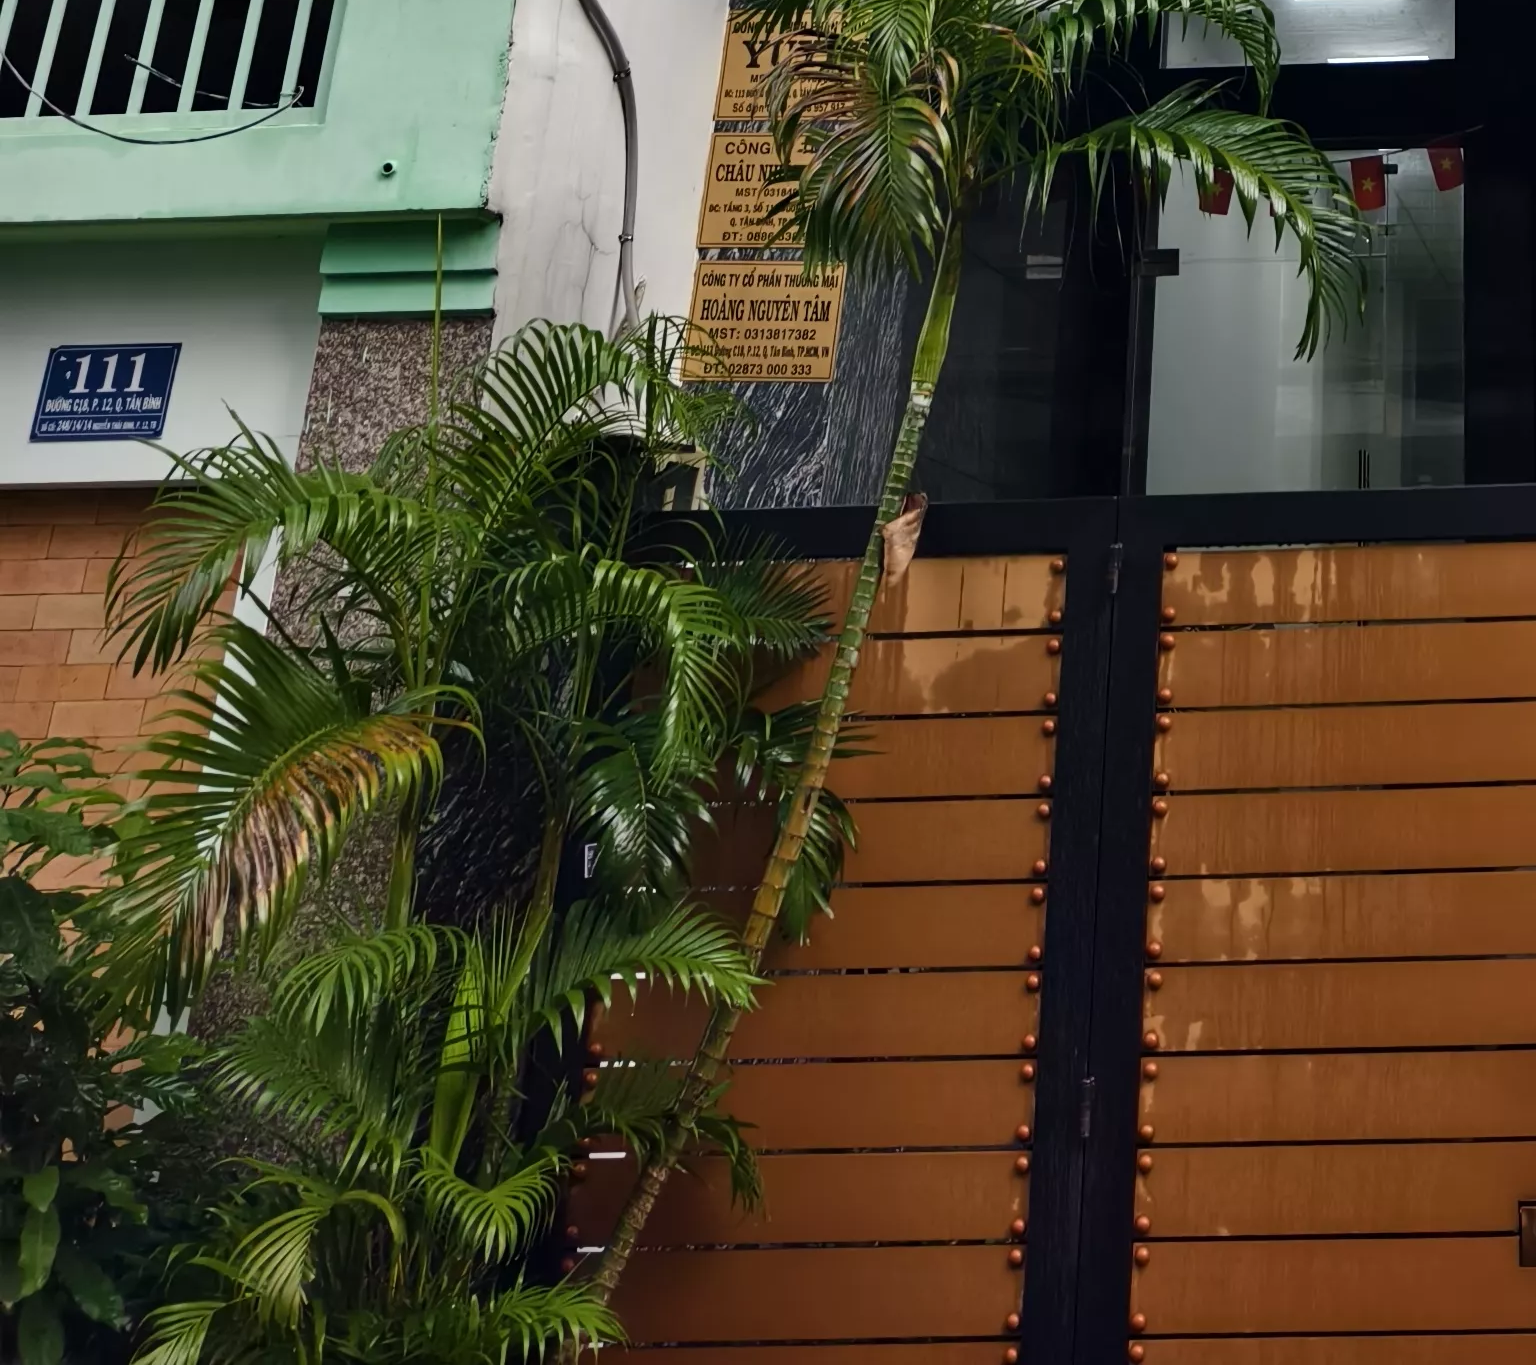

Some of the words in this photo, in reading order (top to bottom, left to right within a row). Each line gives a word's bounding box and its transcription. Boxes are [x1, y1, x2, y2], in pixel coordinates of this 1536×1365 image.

[725, 139, 770, 155] CÔNG
[716, 160, 755, 182] CHÂU
[735, 188, 758, 197] MST
[722, 232, 744, 242] ĐT:
[701, 270, 726, 287] CÔNG
[729, 273, 740, 287] TY
[700, 293, 745, 321] HOÀNG
[803, 294, 832, 322] TÂM
[709, 328, 740, 339] MST:
[69, 353, 146, 394] 111
[728, 363, 763, 375] 02873
[766, 364, 788, 375] 000
[791, 364, 813, 376] 333
